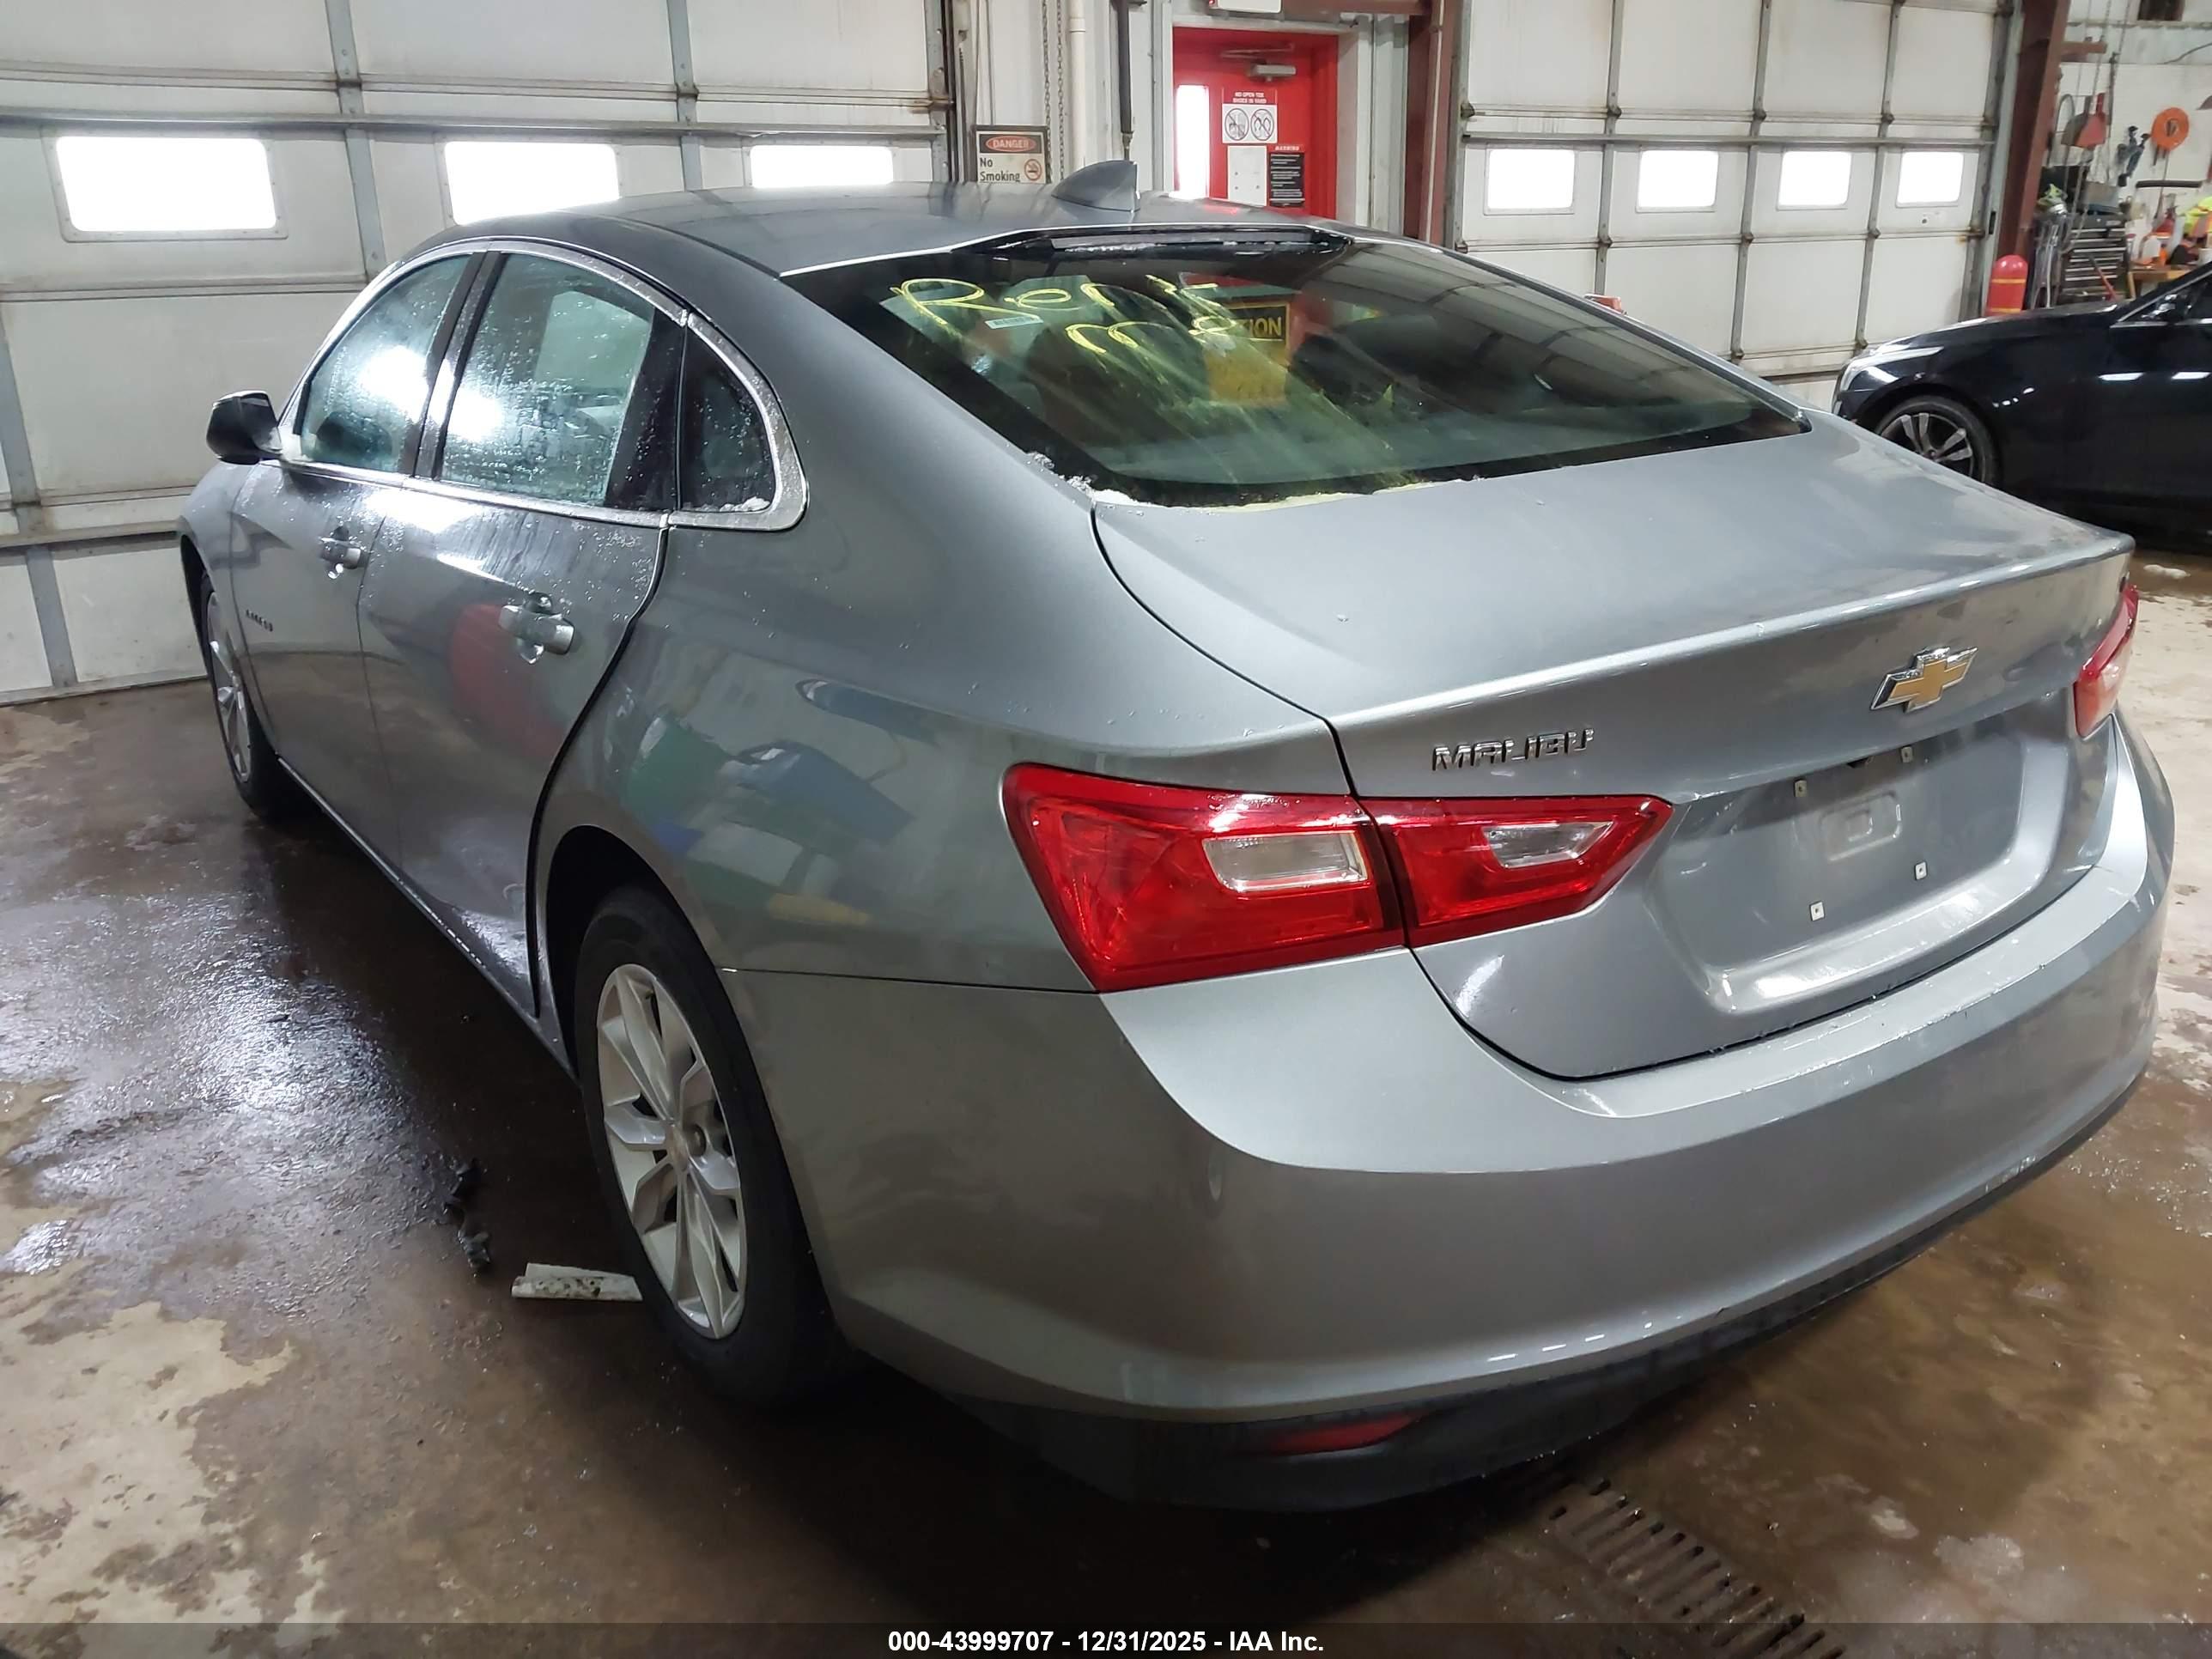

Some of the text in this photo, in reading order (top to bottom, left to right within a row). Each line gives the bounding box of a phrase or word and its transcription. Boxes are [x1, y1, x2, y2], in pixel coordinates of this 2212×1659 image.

[993, 139, 1030, 149] DANGER
[980, 157, 993, 167] No
[980, 170, 1021, 182] Smoking
[1432, 728, 1594, 771] MALIBU
